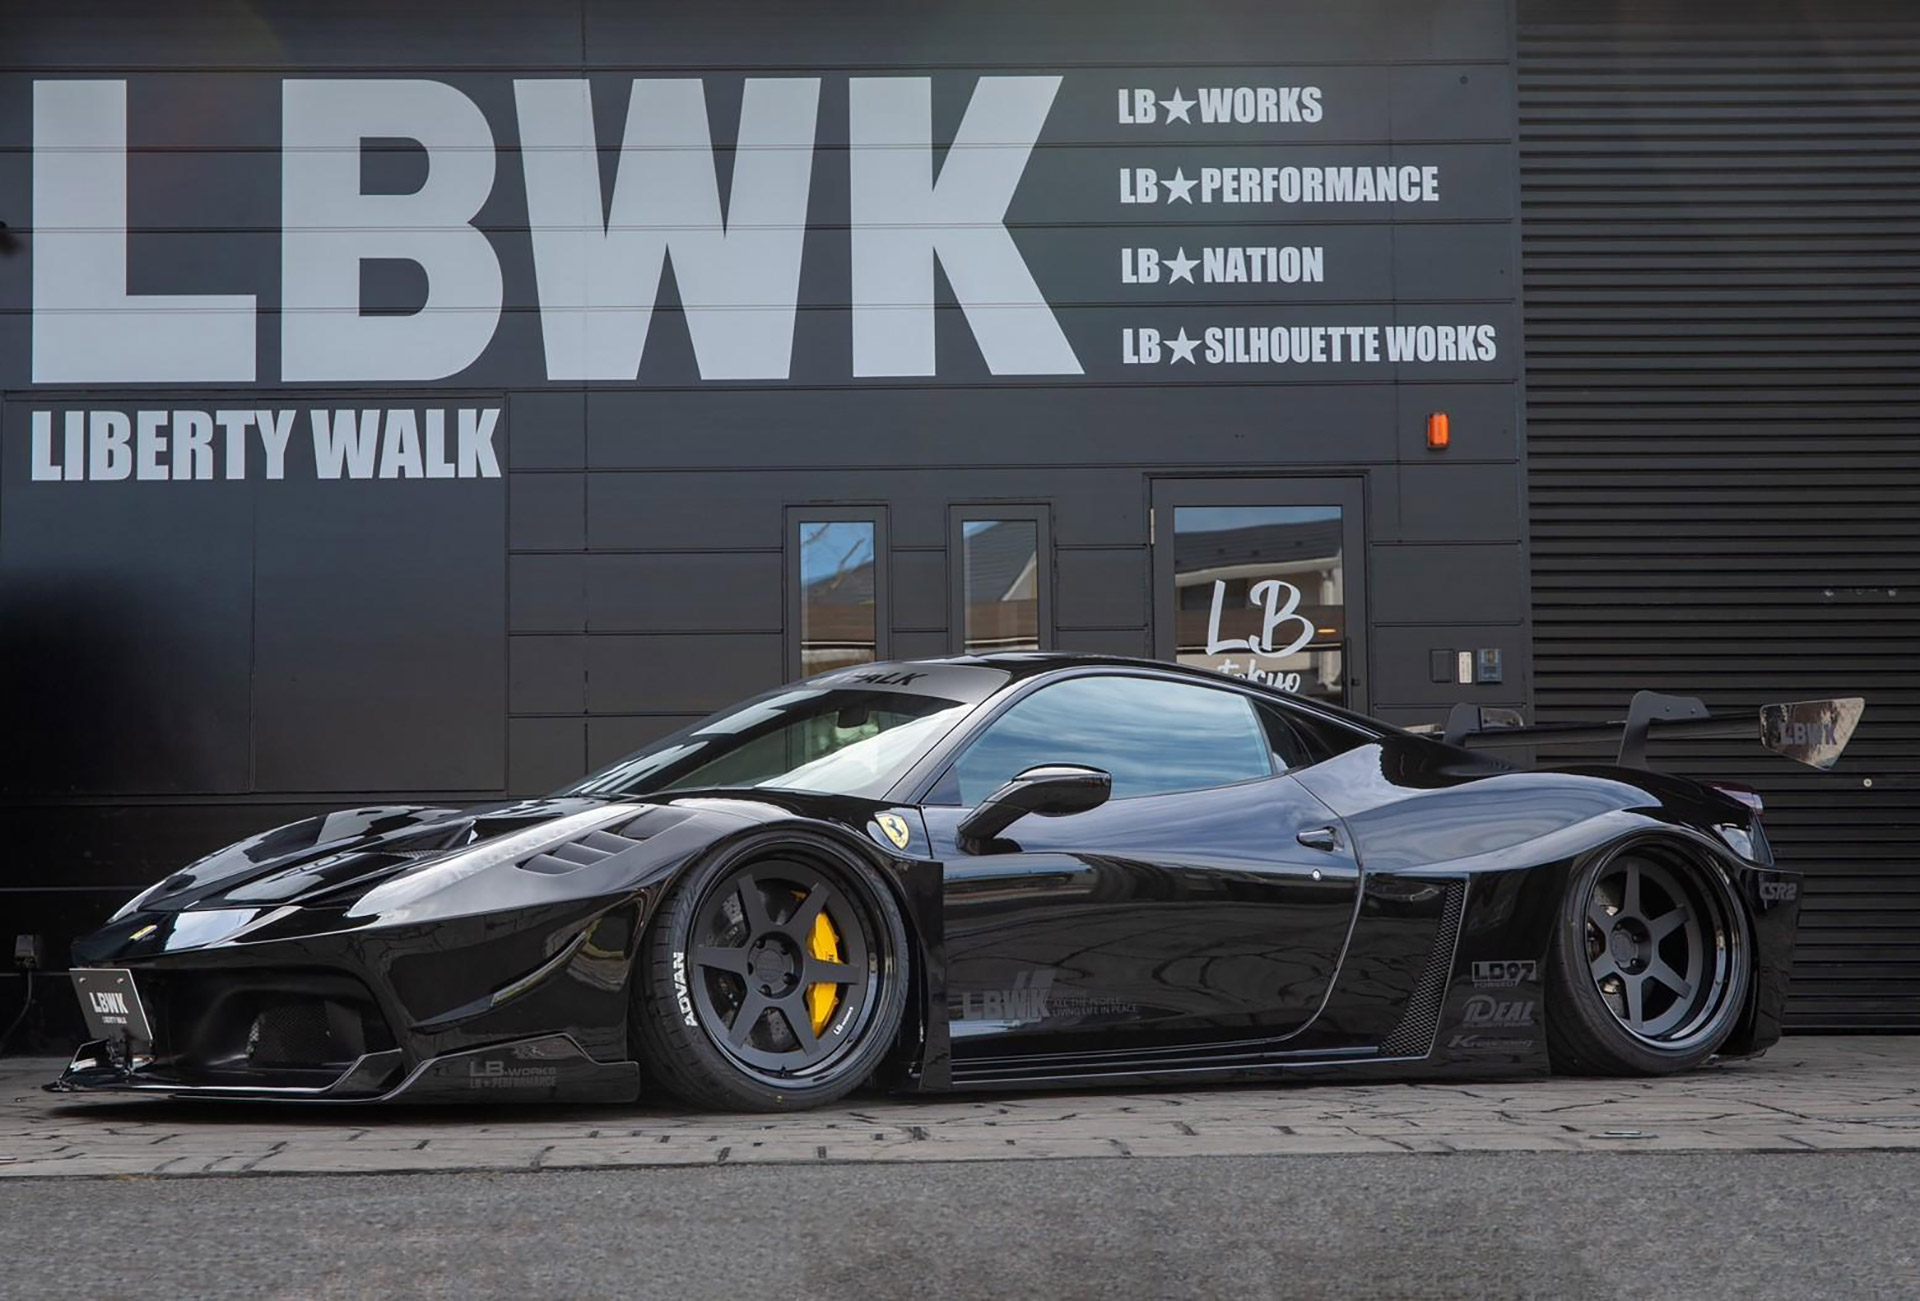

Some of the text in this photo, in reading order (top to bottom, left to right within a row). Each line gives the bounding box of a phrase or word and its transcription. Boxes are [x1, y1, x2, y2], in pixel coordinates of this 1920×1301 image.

[1197, 86, 1323, 124] WORKS
[1200, 165, 1440, 203] PERFORMANCE
[31, 75, 1086, 384] LBWK
[1202, 246, 1324, 283] NATION
[1385, 324, 1497, 362] WORKS
[31, 408, 502, 481] LIBERTY WALK
[1205, 579, 1314, 658] LB
[1778, 721, 1837, 746] LBWK
[1759, 882, 1798, 900] CSR2
[88, 992, 129, 1014] LBWK
[672, 951, 698, 1027] ADVAN
[962, 980, 1054, 1019] LBWK
